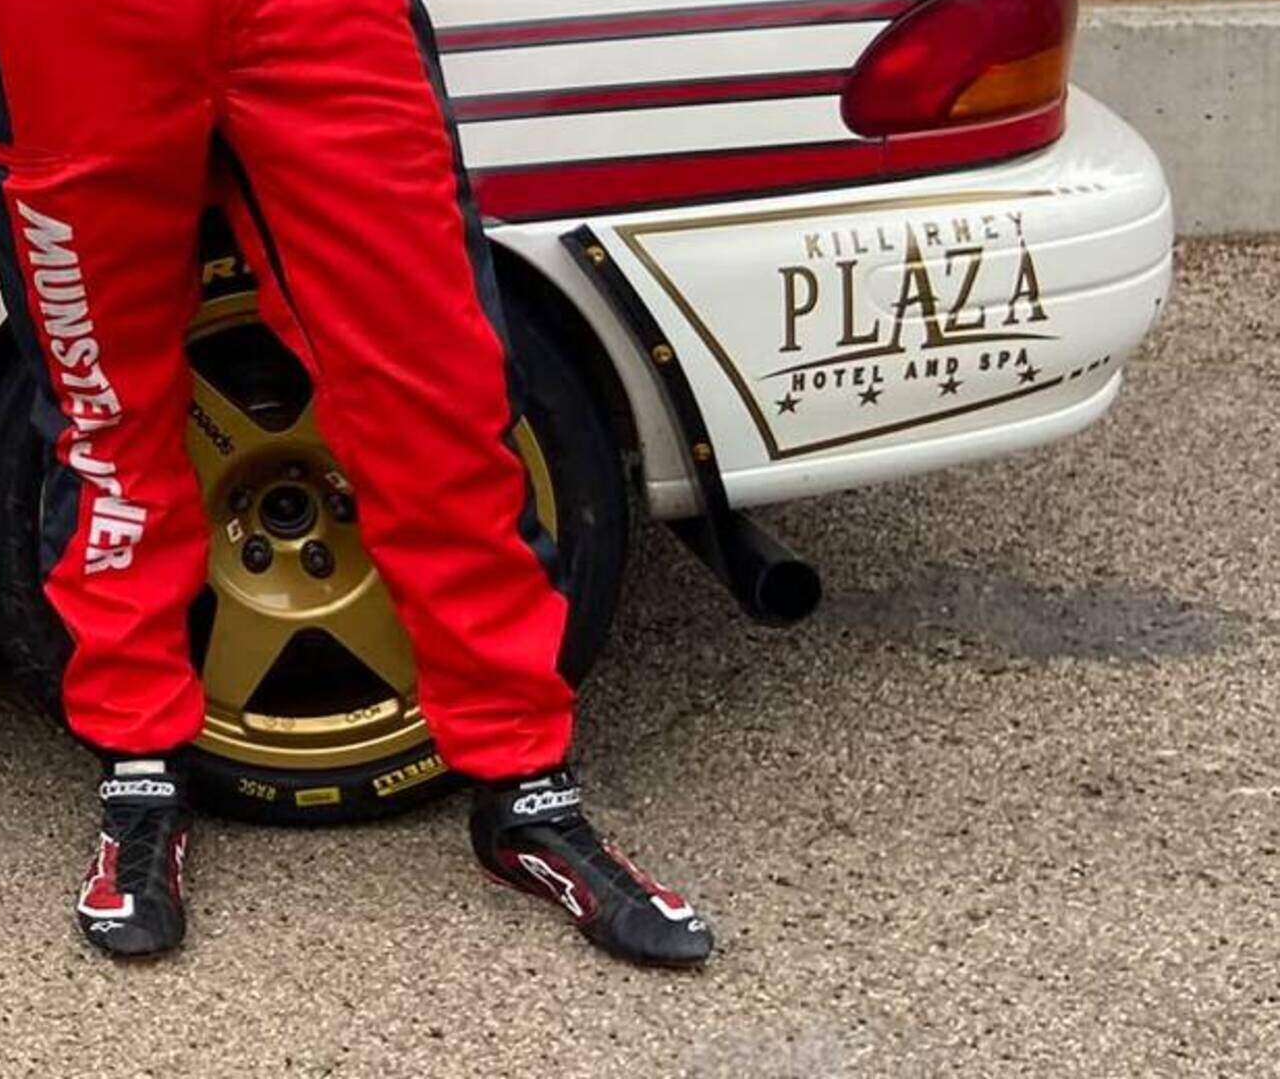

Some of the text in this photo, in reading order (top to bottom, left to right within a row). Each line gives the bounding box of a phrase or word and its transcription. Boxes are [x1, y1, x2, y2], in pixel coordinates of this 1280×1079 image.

[777, 220, 1050, 354] PLAZA
[791, 348, 1029, 392] HOTEL AND SPA
